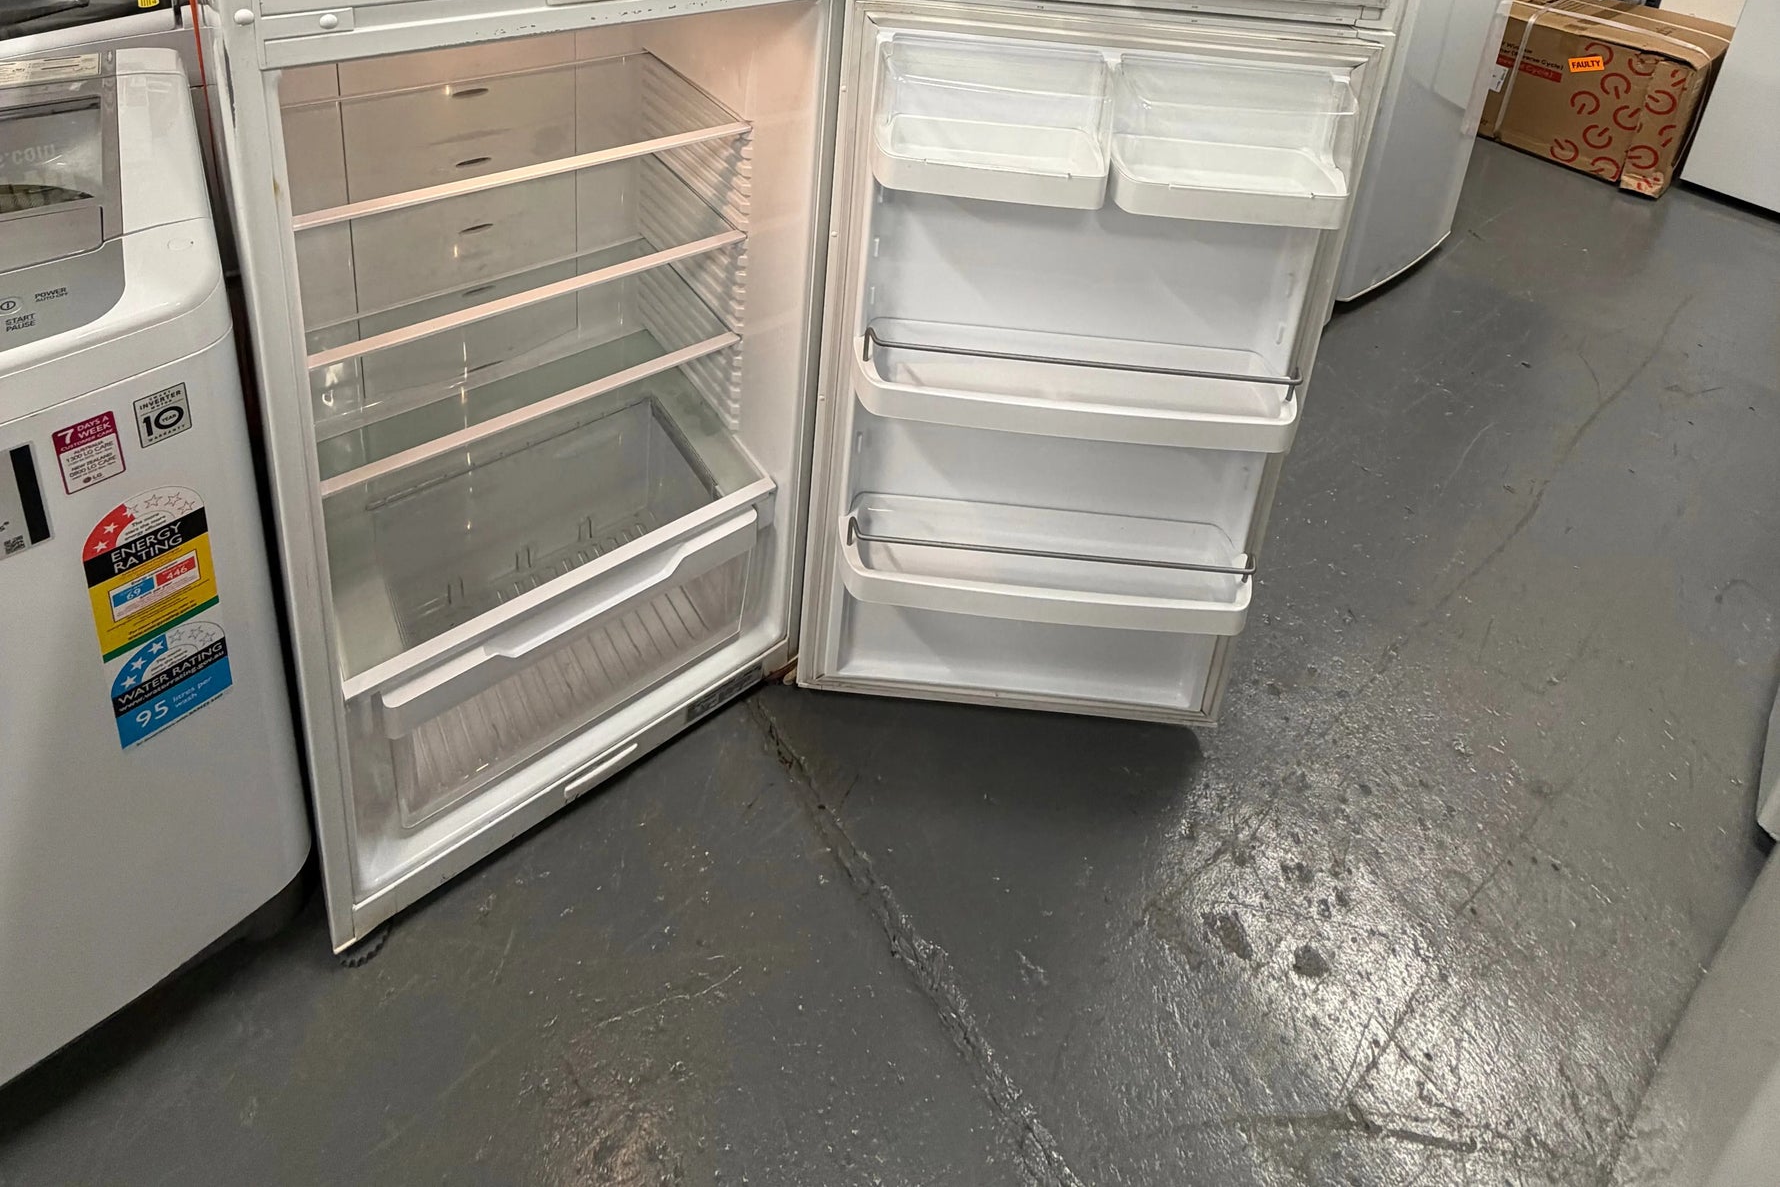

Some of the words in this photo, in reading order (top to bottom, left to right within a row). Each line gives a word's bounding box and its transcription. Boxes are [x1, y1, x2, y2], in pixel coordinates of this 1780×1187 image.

[1571, 60, 1601, 70] FAULTY
[34, 287, 67, 299] POWER
[5, 313, 36, 325] START
[6, 320, 36, 332] PAUSE
[140, 390, 181, 410] INVERTER
[77, 418, 100, 432] DAYS
[143, 406, 184, 437] 10
[162, 413, 177, 422] YEAR
[57, 428, 75, 444] 7
[78, 422, 112, 439] WEEK
[60, 435, 96, 452] CUSTOMER
[94, 441, 114, 453] CARE
[97, 454, 117, 466] CARE
[92, 472, 102, 480] LG
[110, 521, 181, 563] ENERGY
[113, 534, 183, 574] RATING
[126, 587, 141, 600] 69
[166, 564, 188, 580] 446
[118, 672, 169, 704] WATER
[172, 642, 223, 675] RATING
[172, 686, 195, 703] litres
[197, 676, 213, 691] per
[136, 699, 169, 728] 95
